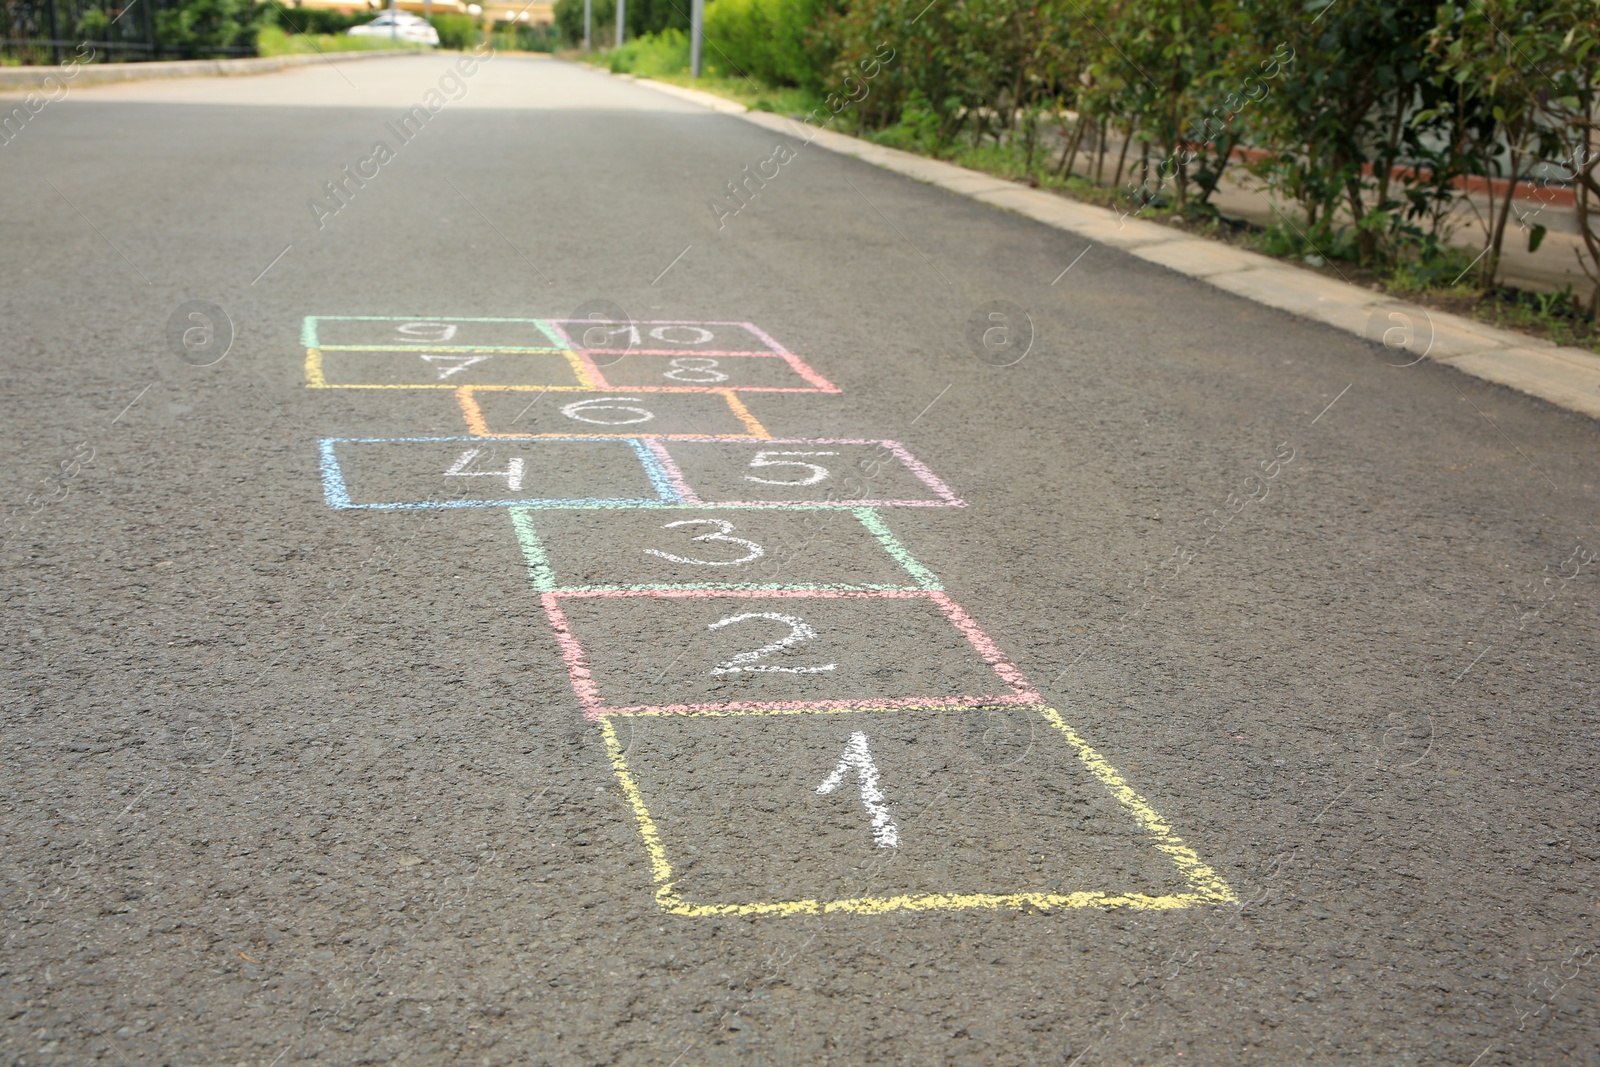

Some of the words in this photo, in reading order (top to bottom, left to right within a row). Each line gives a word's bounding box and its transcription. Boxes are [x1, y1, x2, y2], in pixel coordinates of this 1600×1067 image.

[394, 322, 457, 342] 9
[608, 325, 714, 344] 10
[420, 354, 494, 380] 7
[664, 357, 729, 382] 8
[560, 397, 655, 425] 6
[443, 448, 525, 492] 4
[744, 451, 839, 486] 5
[644, 518, 764, 566] 3
[708, 612, 837, 677] 2
[815, 730, 898, 848] 1
